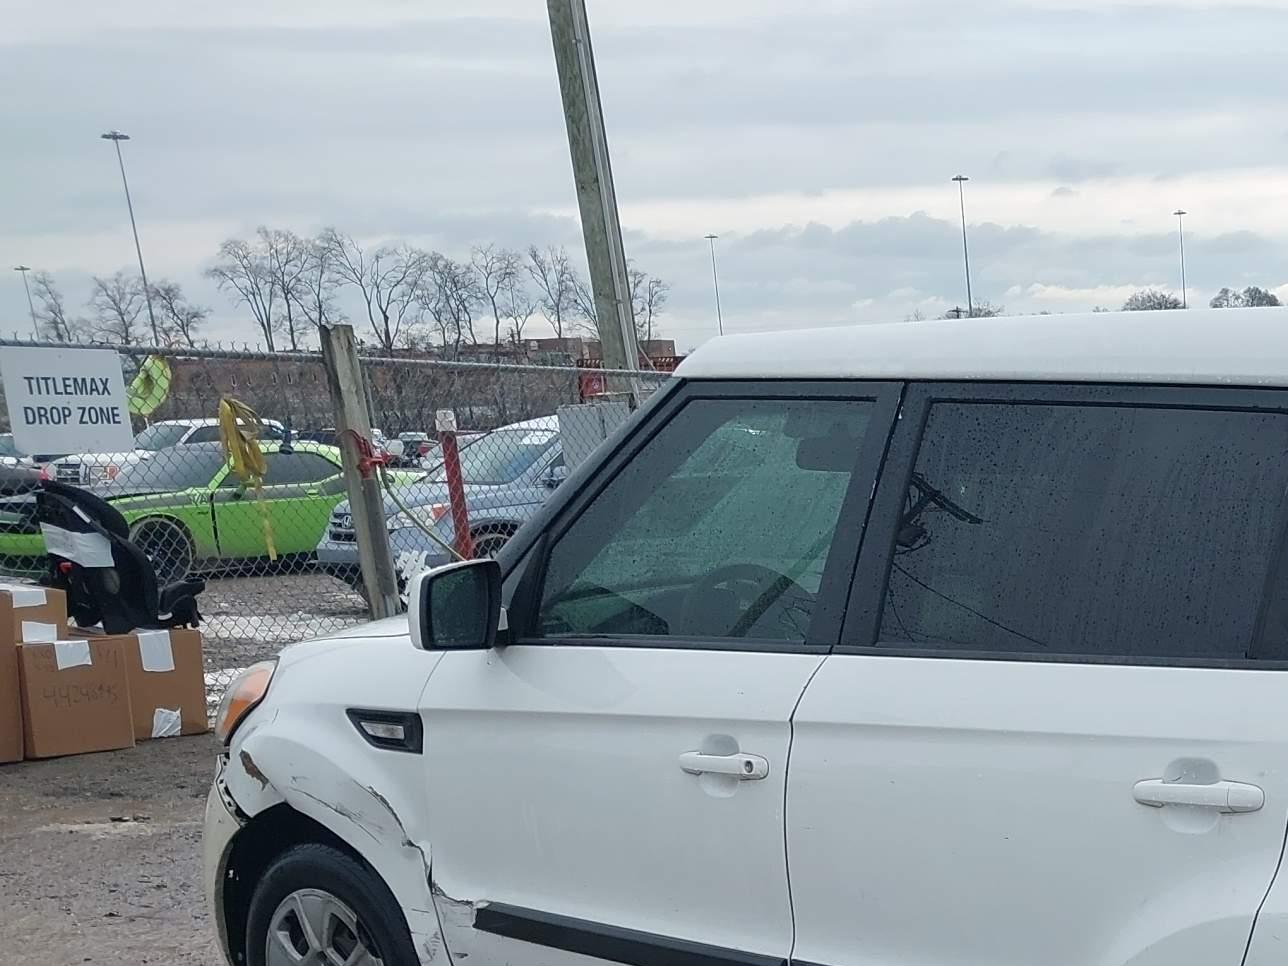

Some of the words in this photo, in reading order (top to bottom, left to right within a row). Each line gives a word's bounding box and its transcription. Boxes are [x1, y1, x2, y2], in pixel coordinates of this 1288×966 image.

[23, 376, 112, 396] TITLEMAX
[23, 406, 72, 425] DROP
[77, 406, 122, 425] ZONE
